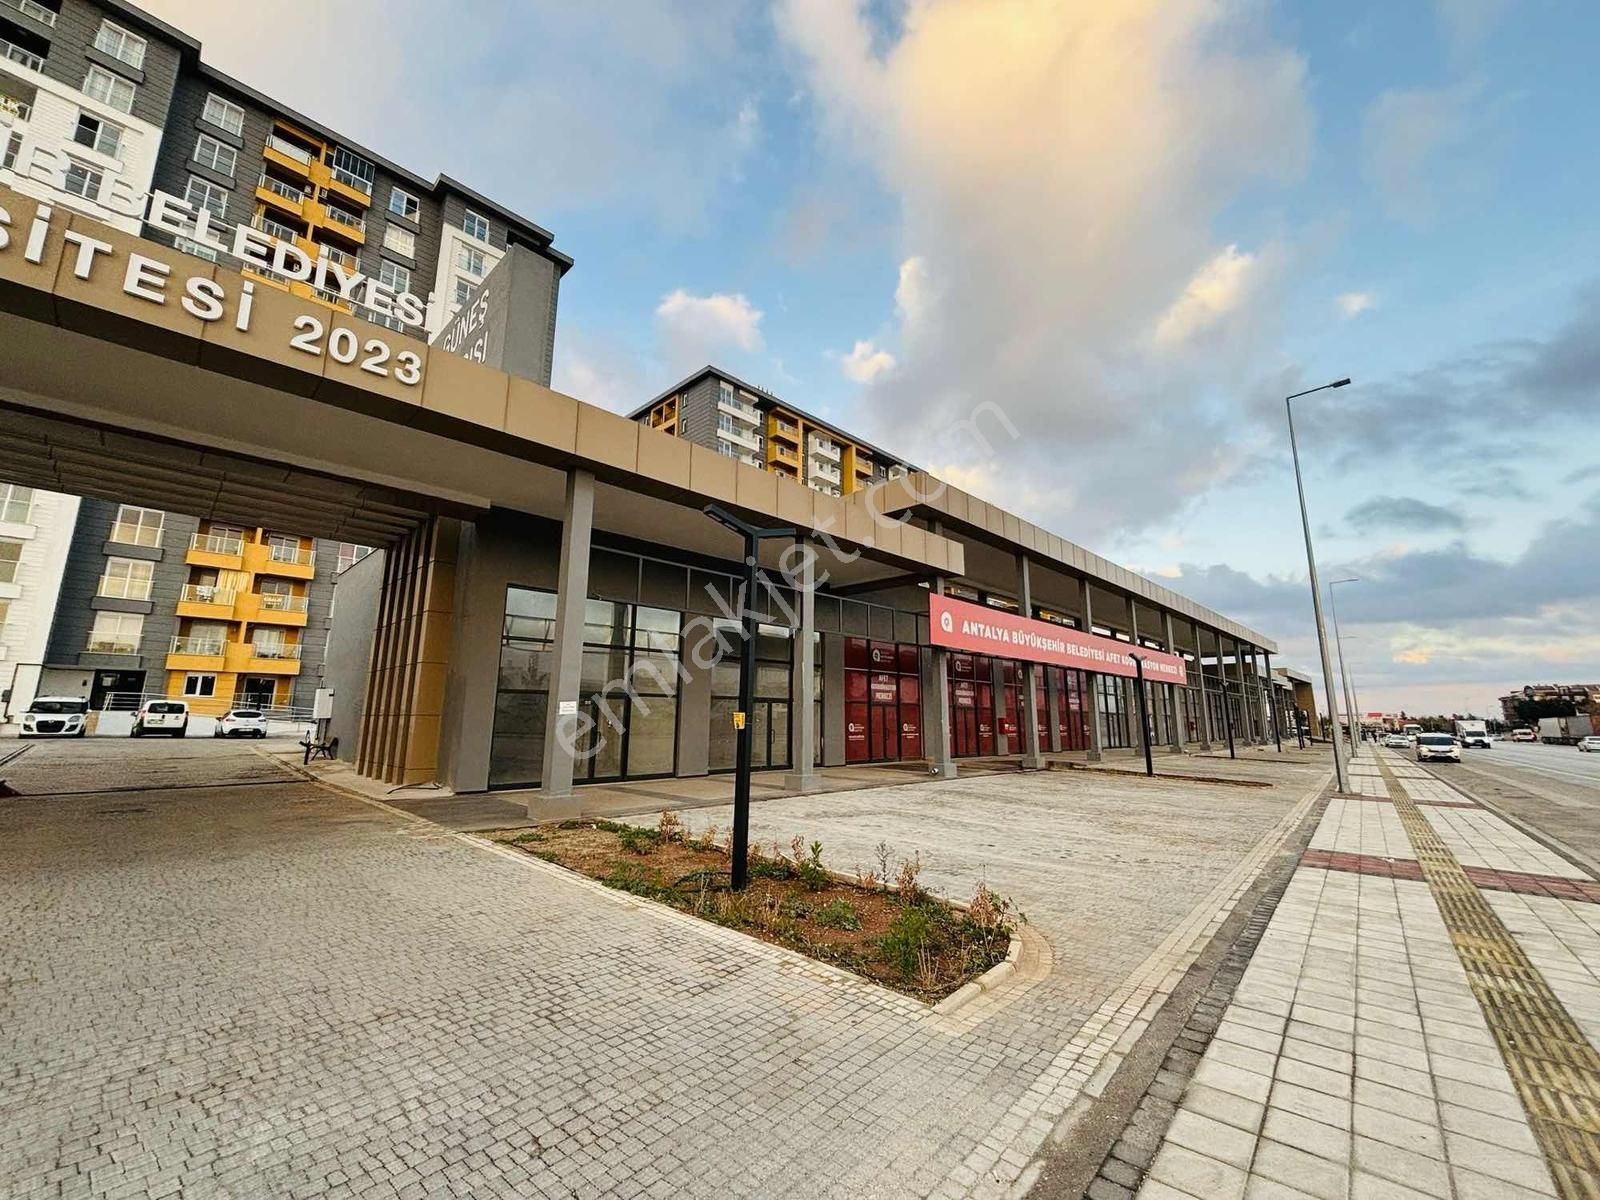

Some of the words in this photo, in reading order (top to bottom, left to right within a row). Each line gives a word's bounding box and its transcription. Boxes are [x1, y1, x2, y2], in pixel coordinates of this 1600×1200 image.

[290, 315, 421, 385] 2023
[962, 620, 1010, 642] ANTALYA
[1012, 630, 1066, 653] BÜYÜKŞEHİR
[1066, 643, 1105, 661] BELEDİYESİ
[1105, 651, 1120, 664] AFET
